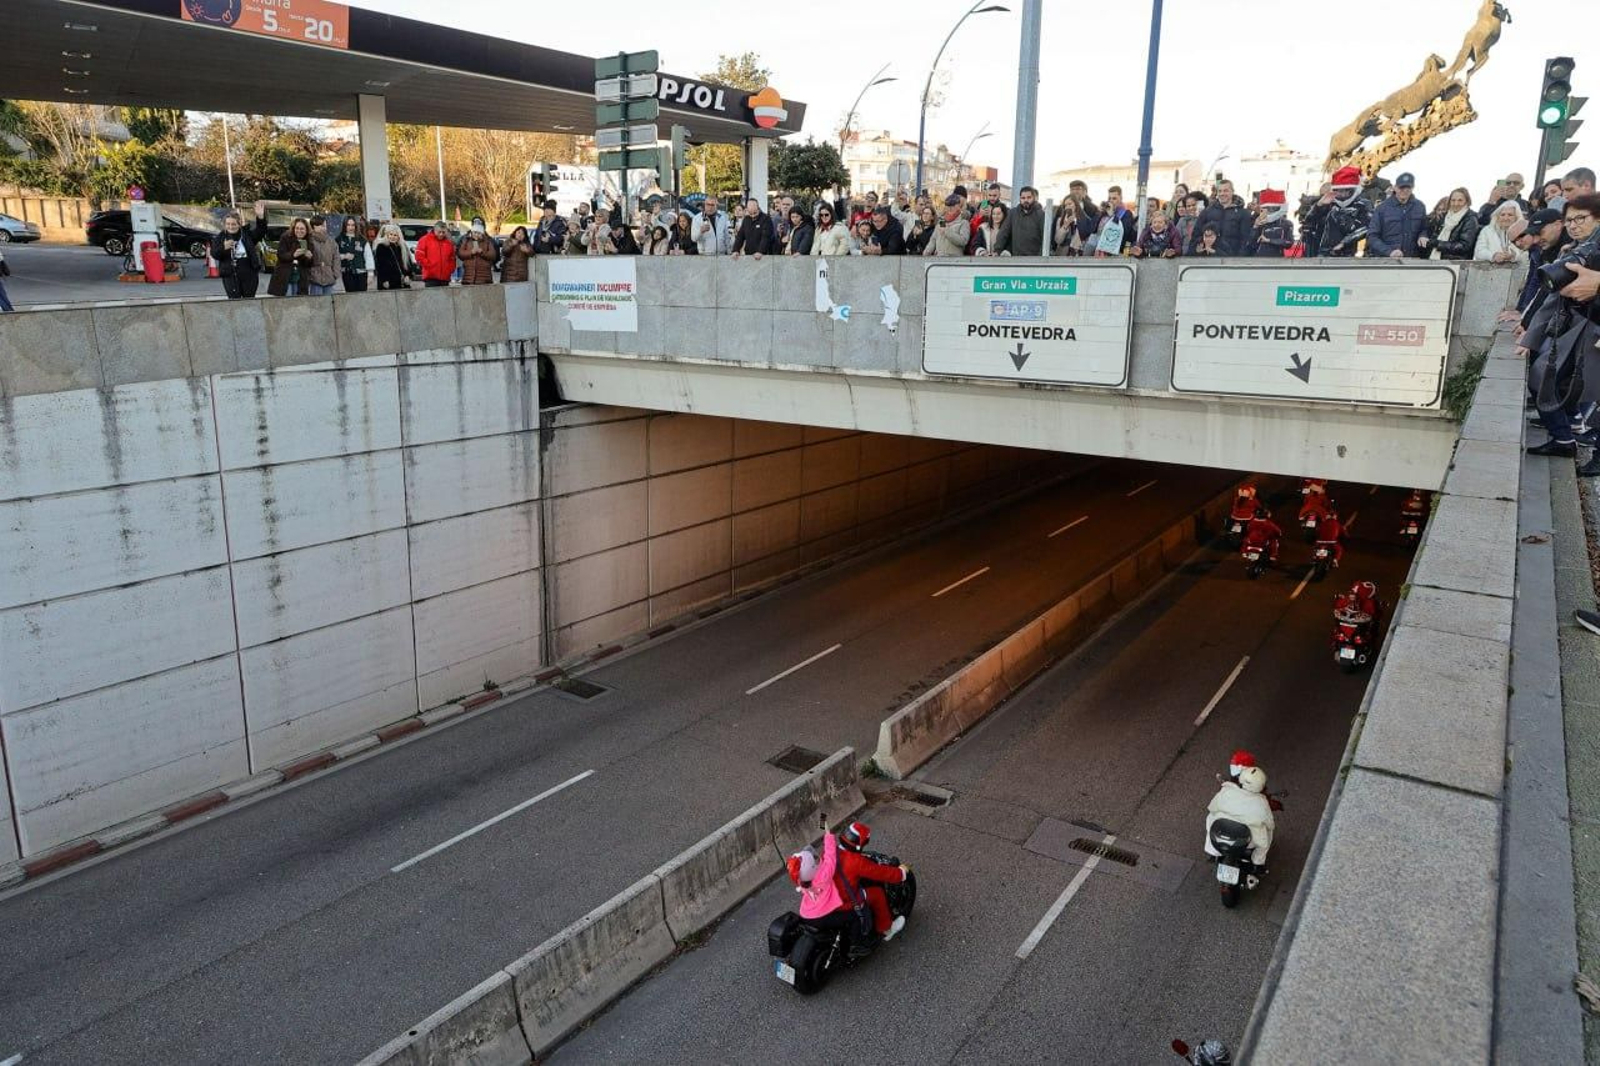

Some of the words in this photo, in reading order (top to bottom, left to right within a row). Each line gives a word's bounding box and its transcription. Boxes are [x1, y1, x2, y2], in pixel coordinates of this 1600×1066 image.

[262, 9, 278, 32] 5
[304, 17, 333, 42] 20
[659, 77, 726, 111] PSOL
[597, 283, 632, 292] INCUMPRE
[981, 280, 1006, 290] Gran
[1035, 280, 1070, 291] Urzaiz
[1284, 290, 1331, 303] Pizarro
[1009, 304, 1042, 317] AP-9
[967, 324, 1077, 341] PONTEVEDRA
[1192, 324, 1331, 342] PONTEVEDRA
[1387, 329, 1419, 342] 550
